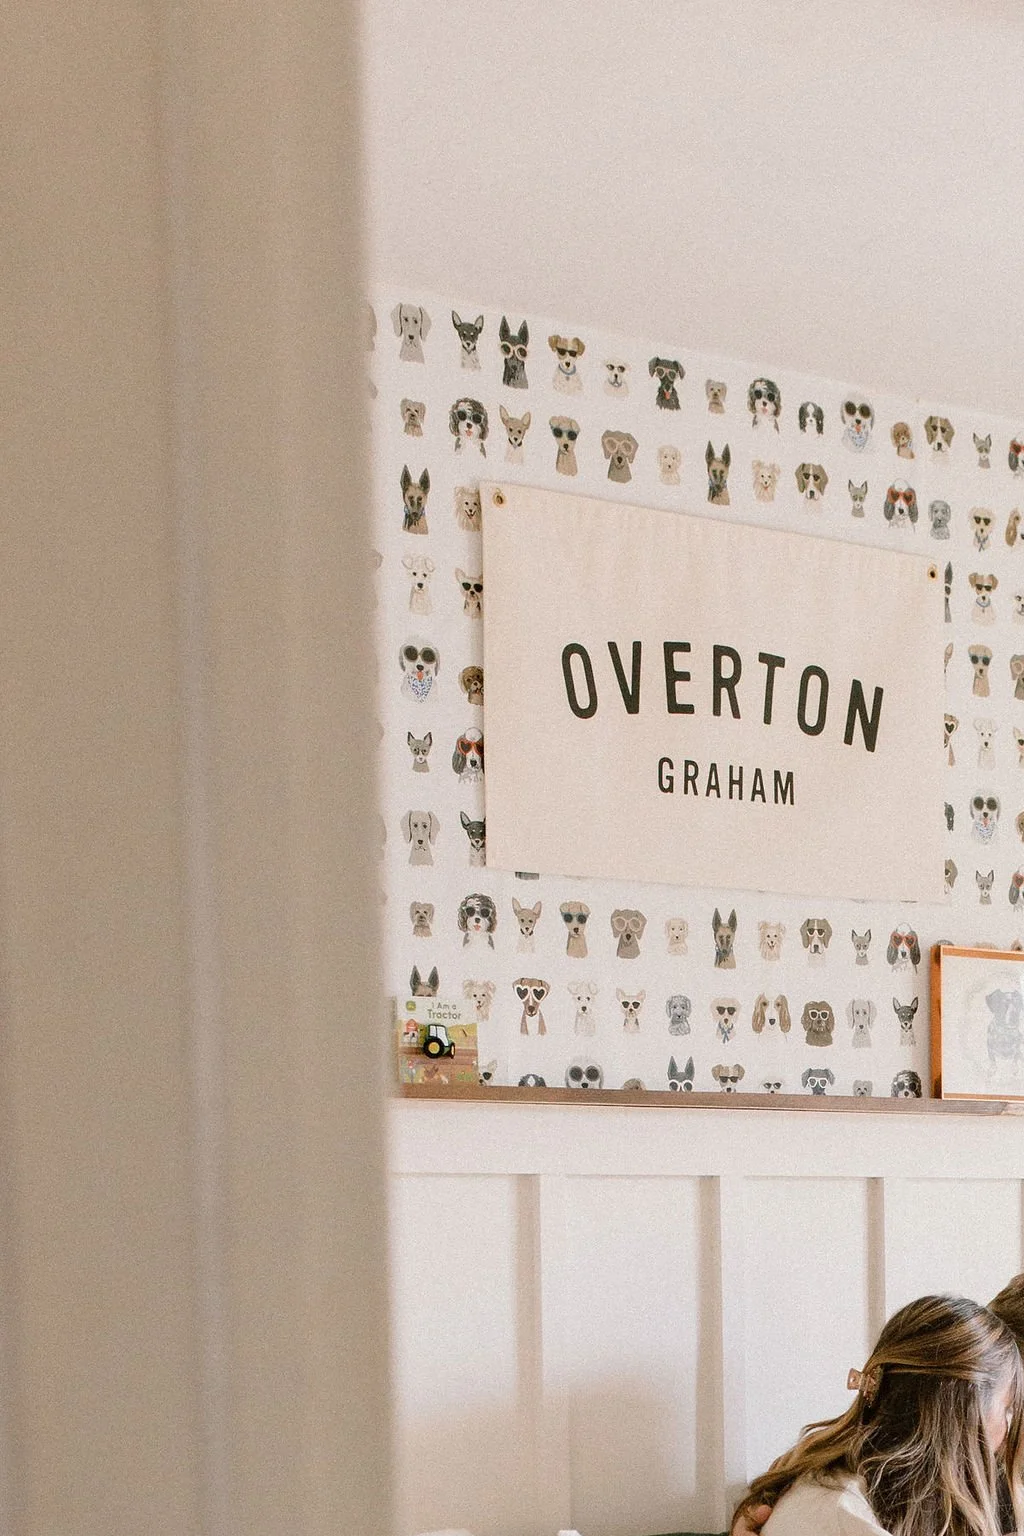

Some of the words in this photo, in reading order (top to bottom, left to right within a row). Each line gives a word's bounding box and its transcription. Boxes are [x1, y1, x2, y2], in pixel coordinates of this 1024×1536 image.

[561, 640, 884, 752] OVERTON
[657, 756, 795, 805] GRAHAM
[427, 1009, 462, 1019] Tractor
[437, 1002, 450, 1010] Am
